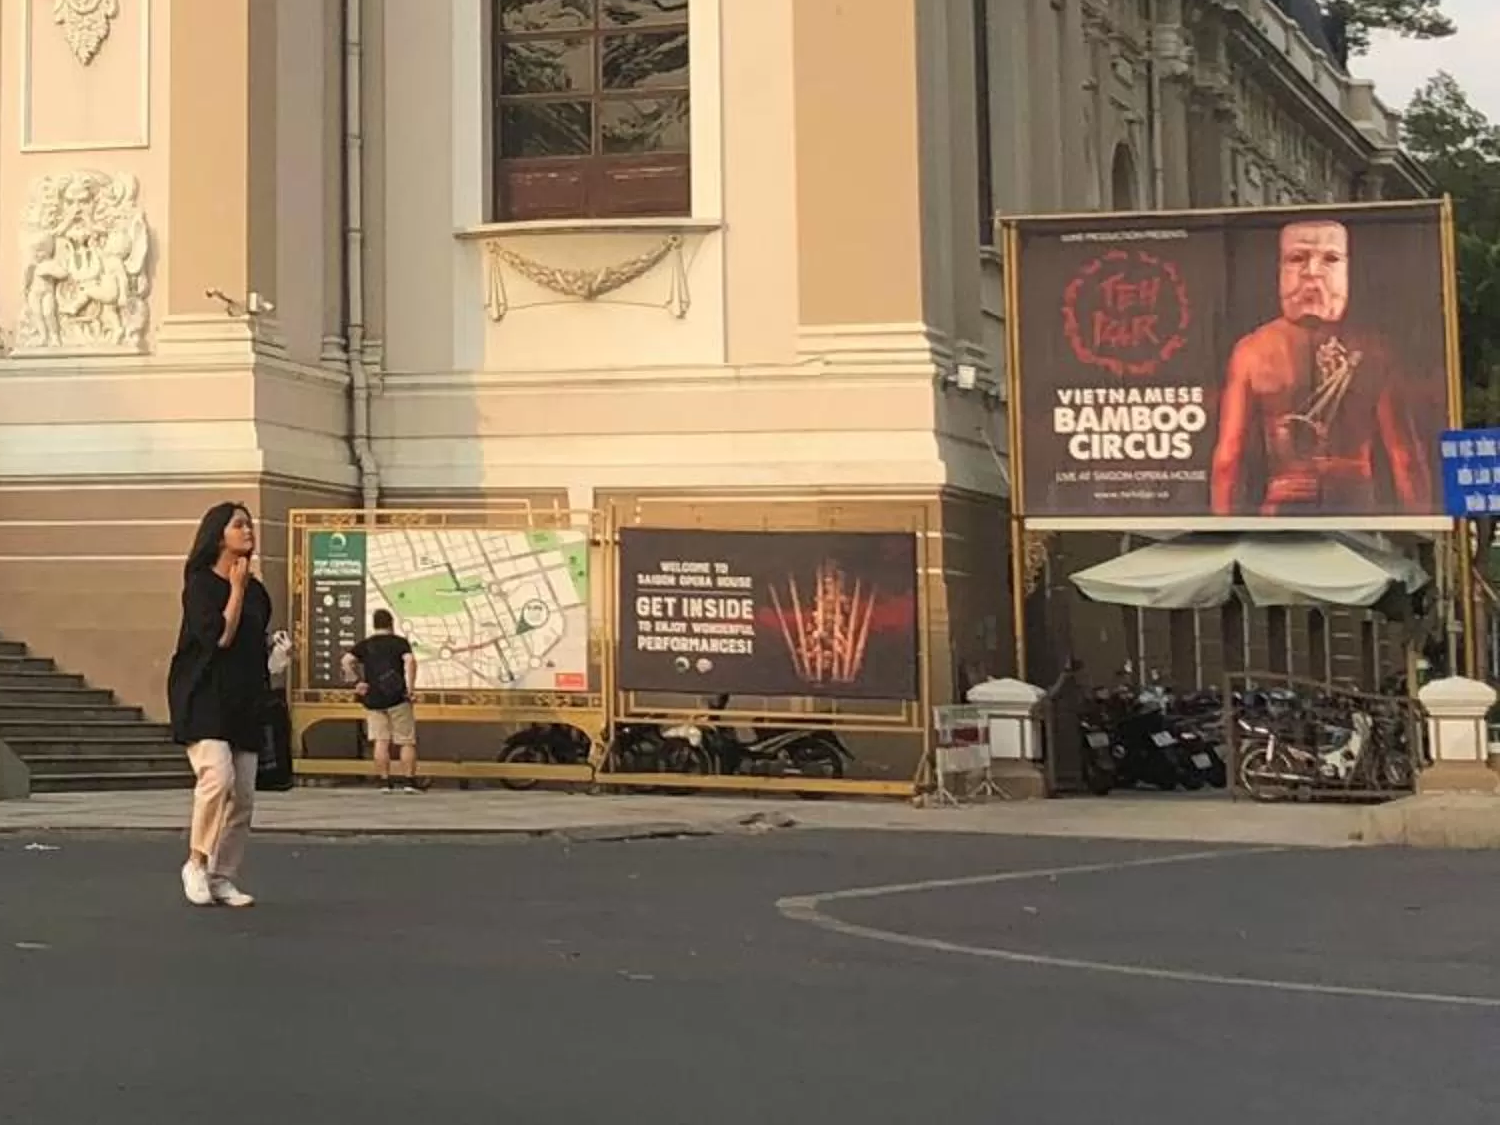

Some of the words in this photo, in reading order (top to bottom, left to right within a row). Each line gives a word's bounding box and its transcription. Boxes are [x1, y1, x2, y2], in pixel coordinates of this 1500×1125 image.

[1056, 386, 1204, 405] VIETNAMESE
[1053, 404, 1207, 433] BAMBOO
[1068, 432, 1193, 460] CIRCUS
[1092, 471, 1132, 481] SAIGON
[1134, 471, 1168, 481] OPERA
[1170, 470, 1206, 481] HOUSE
[660, 561, 710, 573] WELCOME
[713, 562, 728, 574] TO
[637, 573, 676, 586] SAIGON
[679, 575, 713, 588] OPERA
[717, 576, 752, 588] HOUSE
[636, 596, 677, 617] GET
[681, 597, 754, 620] INSIDE
[638, 620, 652, 632] TO
[654, 620, 687, 633] ENJOY
[691, 622, 755, 635] WONDERFUL
[637, 635, 753, 654] PERFORMANCES!
